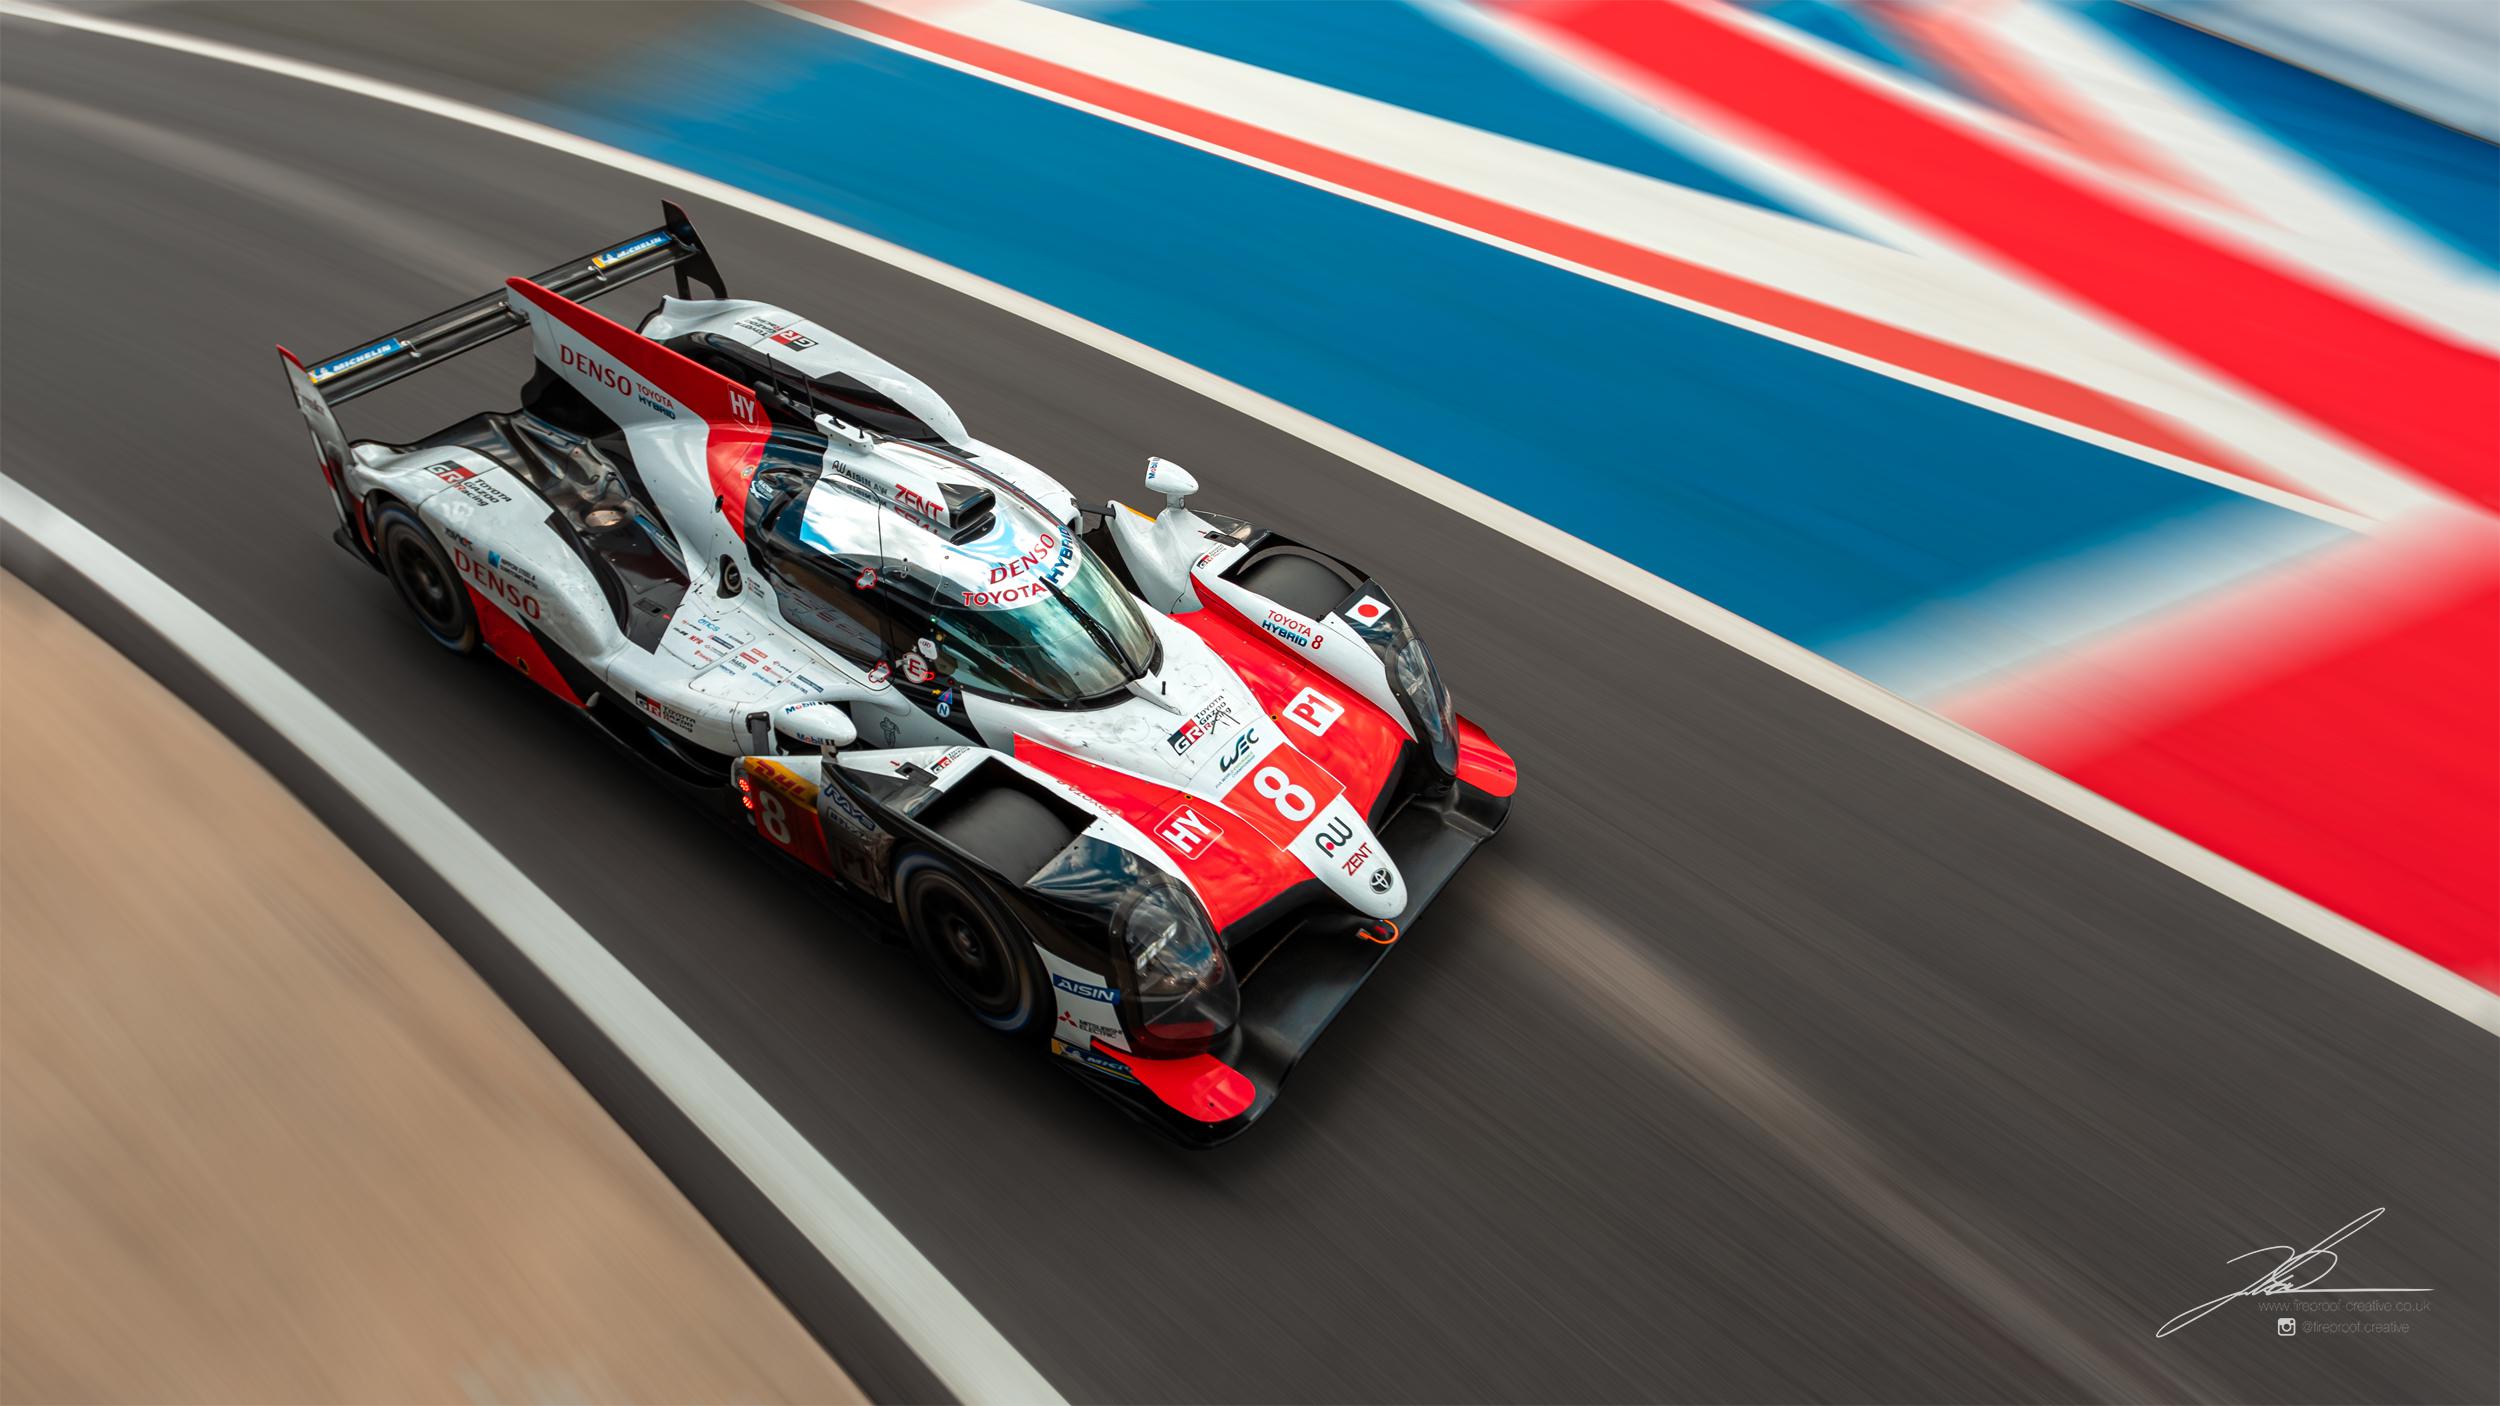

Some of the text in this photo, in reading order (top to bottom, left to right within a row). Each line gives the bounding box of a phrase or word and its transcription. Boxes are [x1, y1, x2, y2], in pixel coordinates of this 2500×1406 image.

[616, 236, 662, 258] MICHELIN
[333, 344, 392, 372] MICHELIN
[560, 344, 632, 396] DENSO
[636, 382, 674, 409] TOYOTA
[638, 395, 676, 420] HYBRID
[730, 390, 755, 423] HY
[455, 484, 489, 506] Racing
[464, 481, 500, 503] GAZOO
[474, 478, 512, 502] TOYOTA
[895, 483, 944, 520] ZENT
[989, 533, 1055, 584] DENSO
[1046, 524, 1074, 584] HYBRID
[453, 547, 541, 620] DENSO
[962, 582, 1048, 606] TOYOTA
[1262, 620, 1308, 647] HYBRID
[1268, 610, 1312, 637] TOYOTA
[1311, 635, 1324, 650] 8
[785, 702, 817, 715] Mobil
[940, 703, 948, 716] N
[1194, 694, 1225, 720] TOYOTA
[1199, 702, 1227, 726] GAZOO
[1293, 693, 1335, 728] P1
[796, 732, 823, 745] Mobil
[1172, 723, 1204, 755] GR
[1219, 727, 1260, 773] WEC
[753, 760, 808, 797] DHL
[1253, 766, 1316, 822] 8
[759, 790, 792, 844] 8
[1162, 809, 1211, 853] HY
[1341, 842, 1373, 876] ZENT
[1057, 979, 1115, 1001] AISIN
